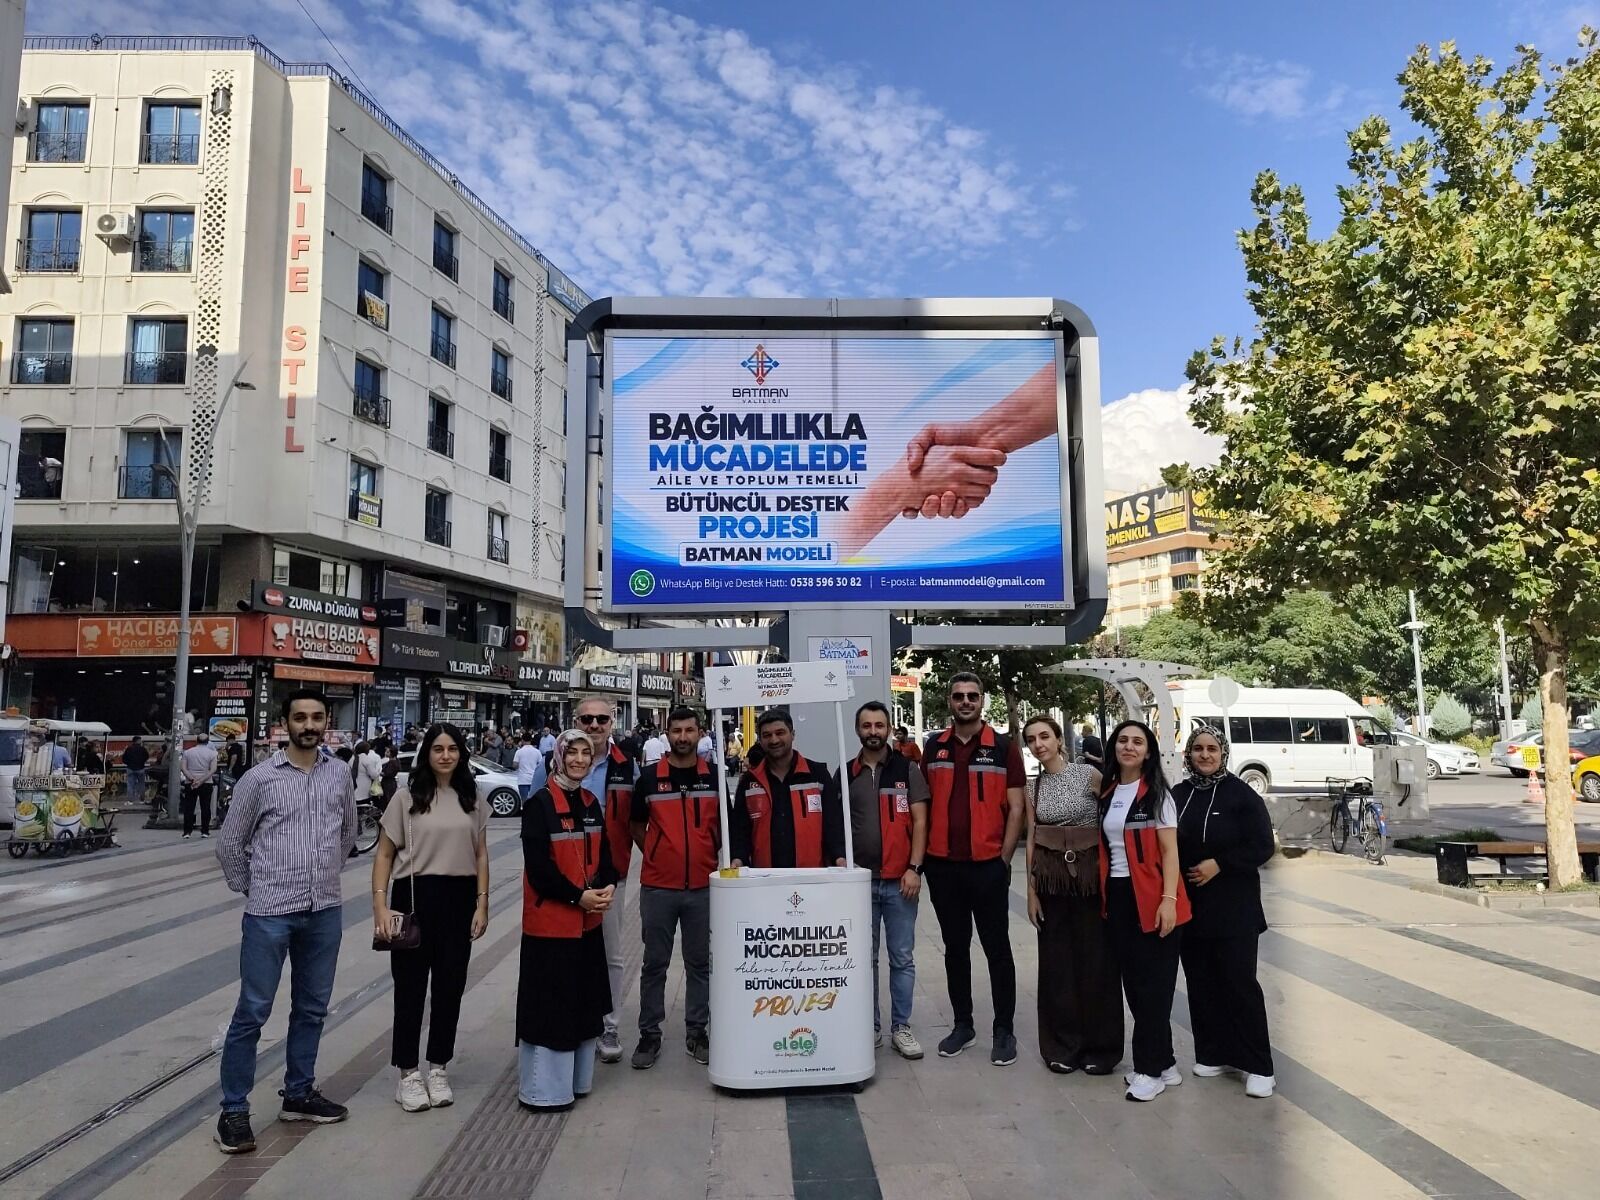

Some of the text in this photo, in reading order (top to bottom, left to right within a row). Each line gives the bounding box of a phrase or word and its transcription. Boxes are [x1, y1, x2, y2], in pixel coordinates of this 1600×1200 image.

[289, 168, 312, 292] LIFE
[732, 388, 789, 398] BATMAN
[649, 405, 868, 441] BAĞIMLILIKLA
[649, 440, 867, 472] MÜCADELEDE
[657, 473, 858, 485] AİLE VE TOPLUM TEMELLİ
[666, 492, 849, 512] BÜTÜNCÜL DESTEK
[699, 511, 818, 539] PROJESİ
[685, 542, 832, 562] BATMAN MODELİ
[660, 579, 702, 589] WhatsApp
[705, 578, 723, 590] Bilgi
[724, 580, 734, 588] ve
[735, 577, 764, 588] Destek
[790, 577, 813, 587] 0538
[816, 577, 834, 587] 596
[836, 577, 848, 587] 30
[850, 576, 862, 587] 82
[881, 576, 1045, 588] E-posta: batmanmodeli@gmail.com
[288, 596, 323, 613] ZURNA
[325, 600, 359, 619] DÜRÜM
[107, 619, 205, 637] HACIBAA
[291, 619, 367, 644] HACIBABA
[295, 637, 362, 655] Döner Salonu
[819, 649, 860, 659] BATMAN
[641, 674, 673, 691] SOSYETE
[216, 698, 245, 707] ZURNA
[82, 776, 101, 786] USTA
[744, 924, 847, 941] BAĞIMLILIKLA
[744, 941, 848, 958] MÜCADELEDE
[734, 961, 762, 973] Aile
[780, 960, 817, 977] Toplum
[819, 958, 857, 973] Temelli
[745, 976, 848, 990] BÜTÜNCÜL DESTEK
[753, 989, 839, 1018] PROJESİ
[773, 1036, 787, 1050] el
[790, 1035, 813, 1050] ele
